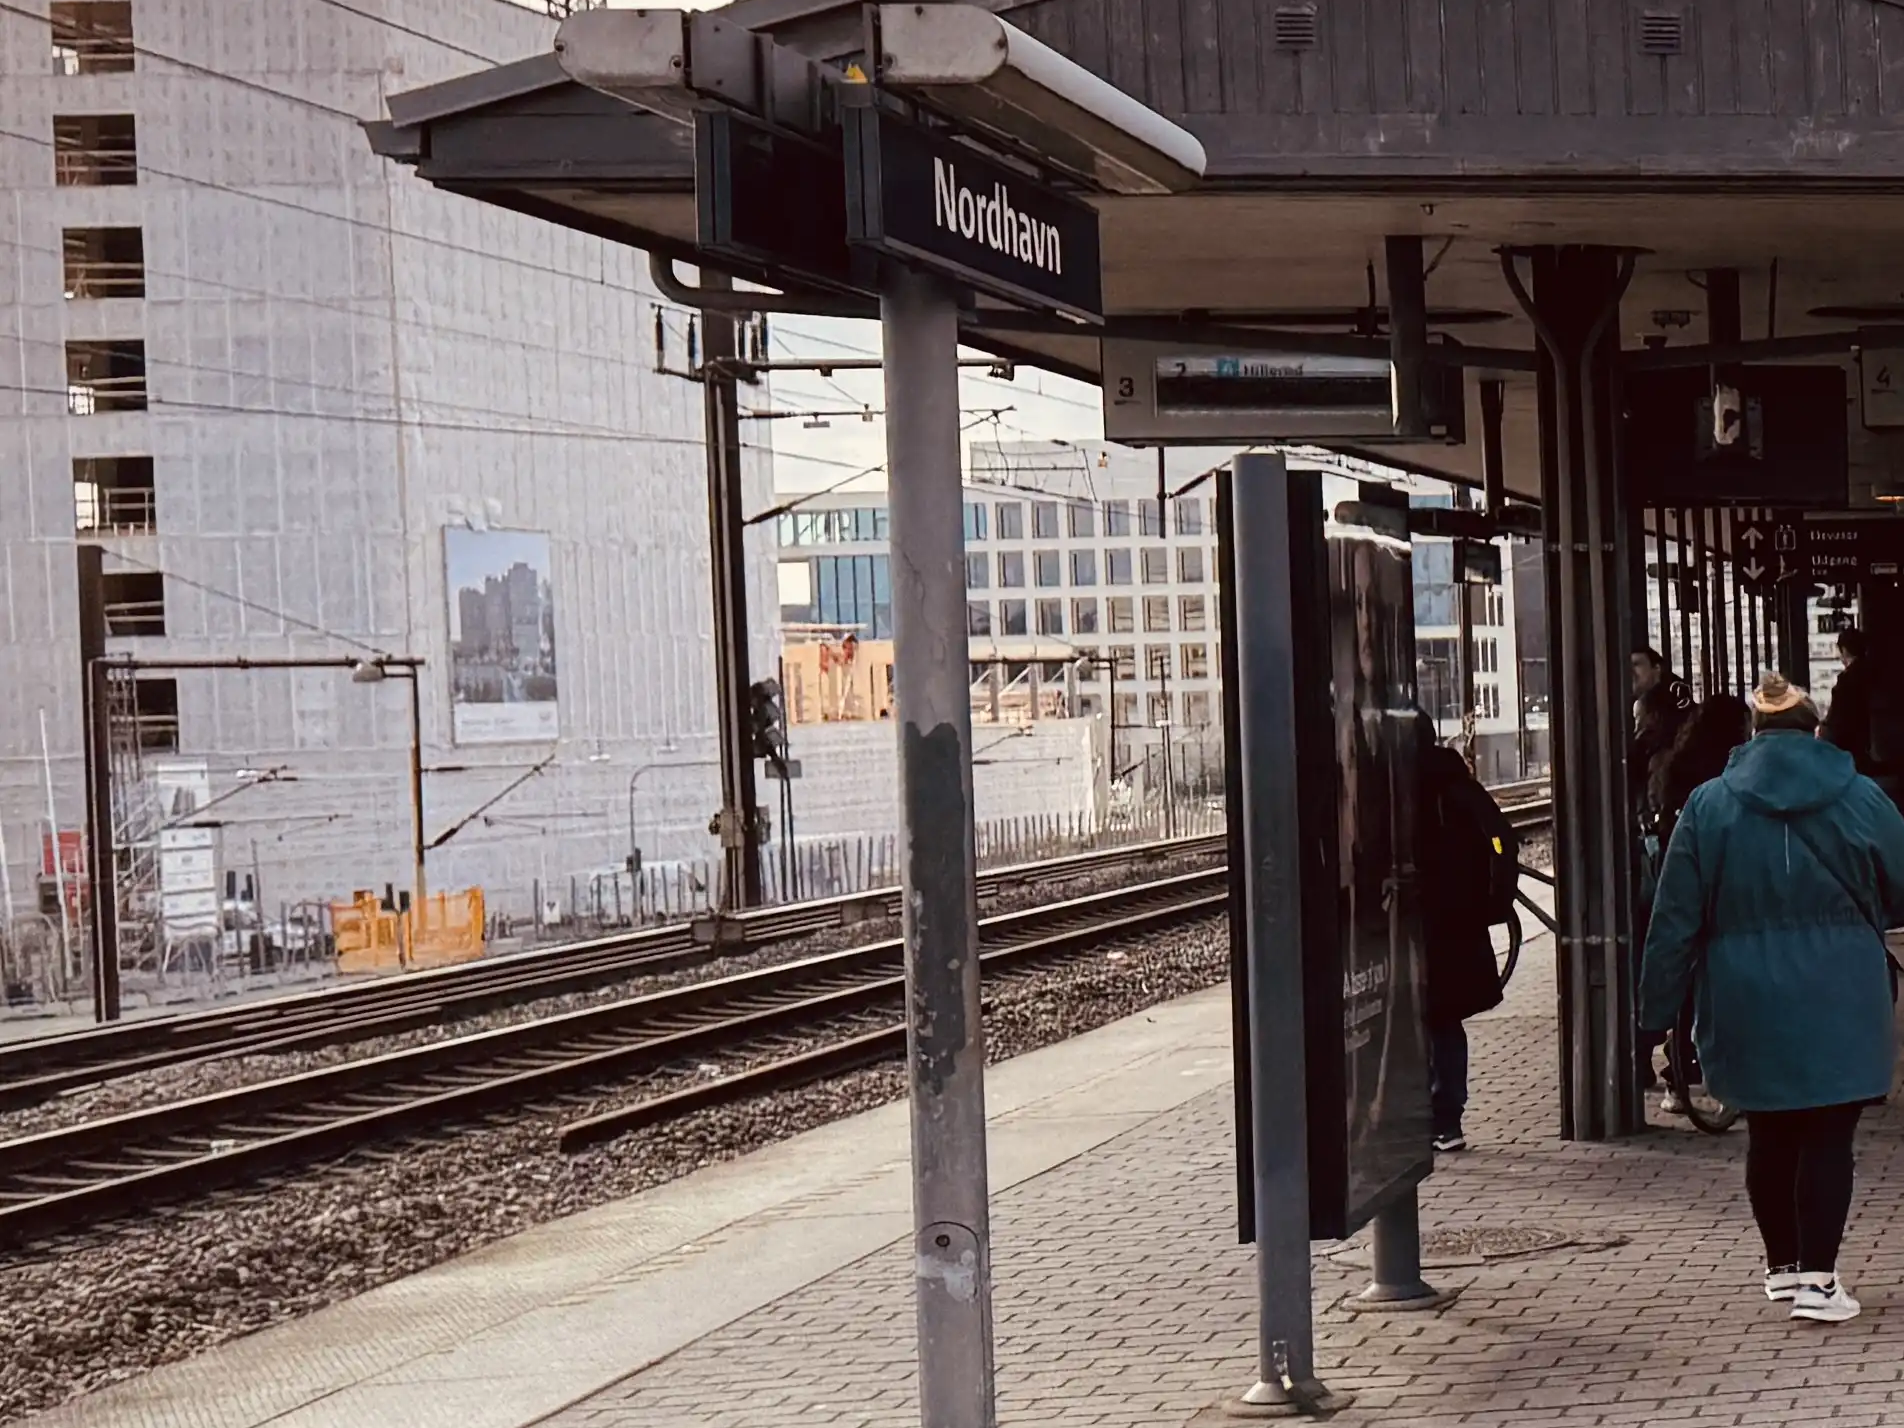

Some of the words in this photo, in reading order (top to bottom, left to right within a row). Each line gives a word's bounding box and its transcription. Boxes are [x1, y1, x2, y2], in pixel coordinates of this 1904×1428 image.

[934, 156, 1062, 275] Nordhavn
[1118, 376, 1135, 398] 3
[1875, 365, 1892, 387] 4
